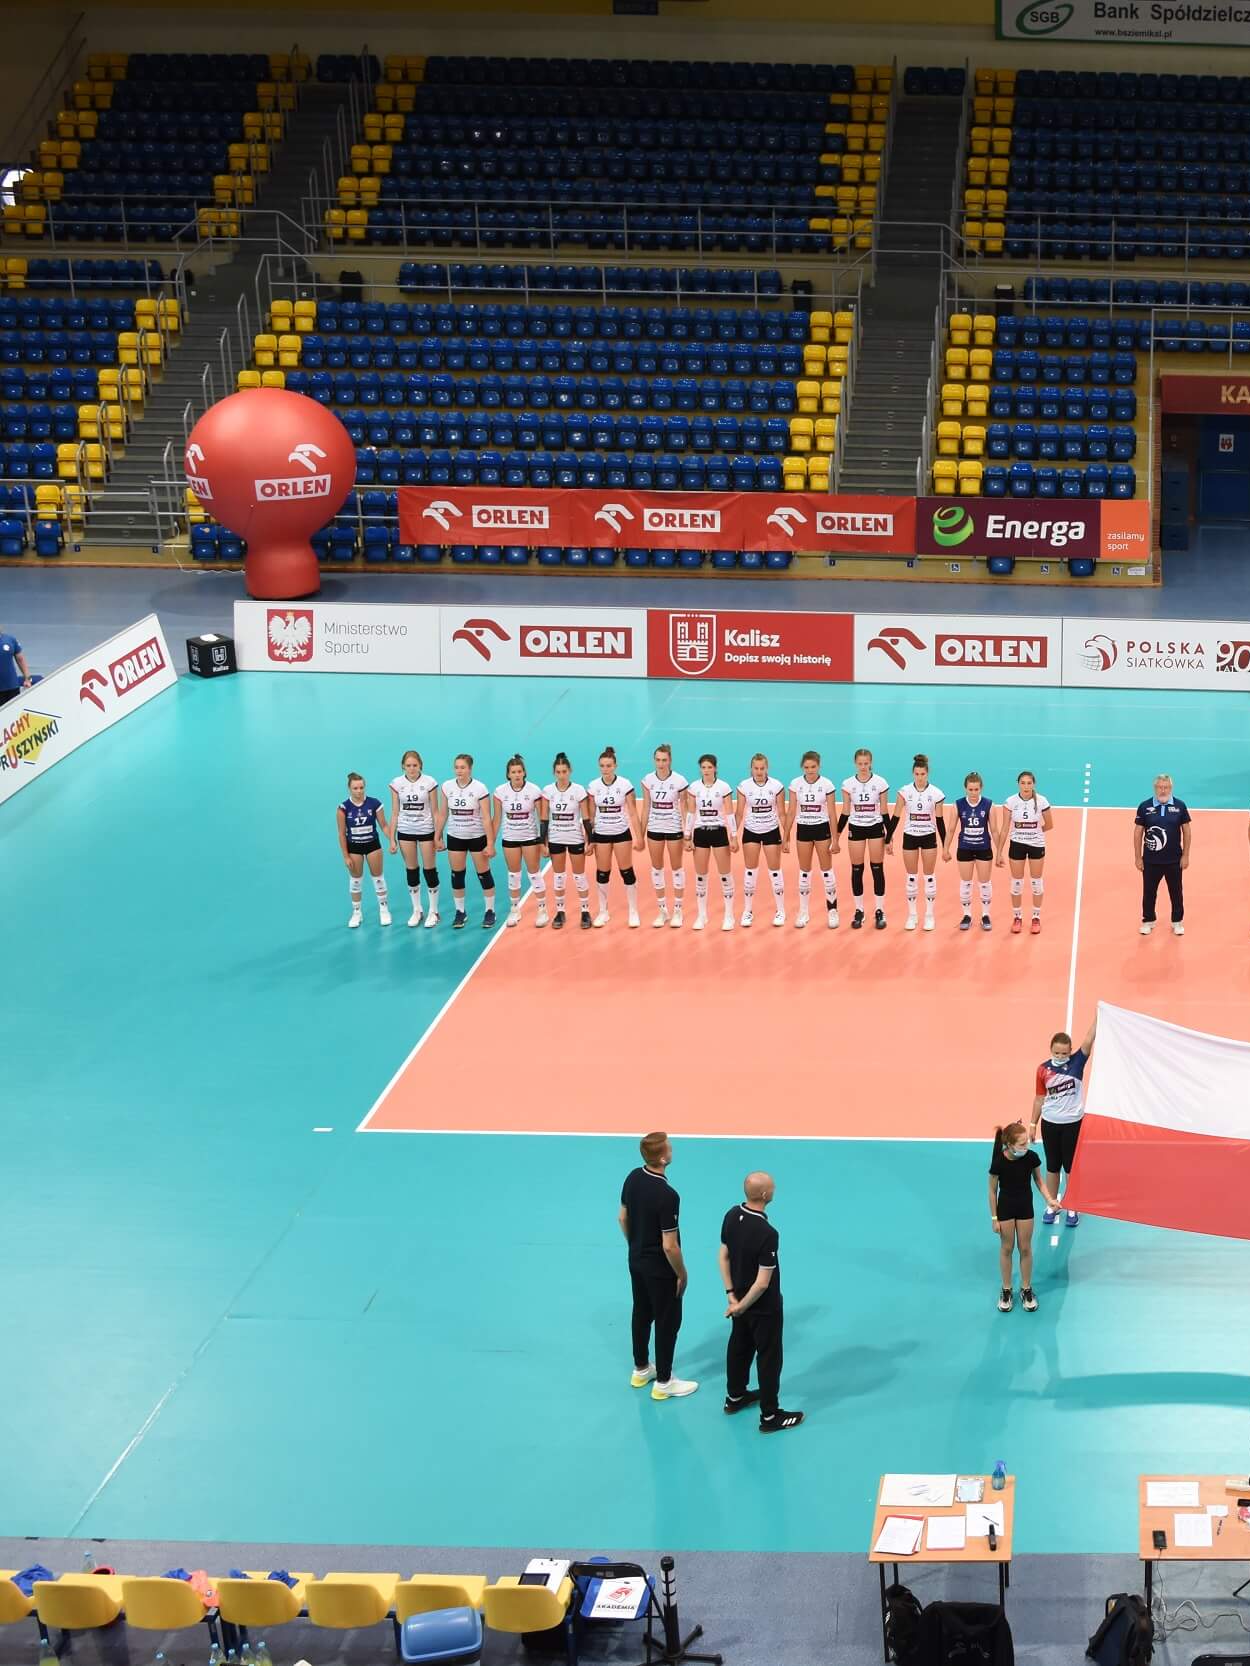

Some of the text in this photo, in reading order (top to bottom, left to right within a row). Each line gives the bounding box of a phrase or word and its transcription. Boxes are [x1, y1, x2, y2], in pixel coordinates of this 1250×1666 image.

[1093, 2, 1139, 20] Bank
[1030, 11, 1060, 24] SGB
[260, 478, 327, 497] ORLEN
[476, 508, 544, 525] ORLEN
[648, 512, 716, 529] ORLEN
[820, 515, 888, 532] ORLEN
[985, 514, 1086, 547] Energa
[1107, 531, 1145, 543] zasilamy
[1107, 542, 1129, 552] sport
[324, 621, 408, 637] Ministerstwo
[525, 629, 625, 655] ORLEN
[724, 628, 780, 647] Kalisz
[324, 639, 369, 655] Sportu
[940, 638, 1041, 664] ORLEN
[1126, 640, 1205, 656] POLSKA
[724, 652, 832, 667] Dopisz swoją historię
[1126, 655, 1205, 670] SIATKÓWKA
[113, 643, 162, 690] ORLEN
[406, 794, 419, 802] 19
[602, 796, 615, 805] 43
[655, 791, 667, 800] 77
[804, 794, 815, 802] 13
[859, 793, 870, 802] 15
[454, 798, 467, 807] 36
[510, 802, 522, 811] 18
[555, 803, 568, 812] 97
[702, 799, 713, 808] 14
[754, 798, 768, 806] 70
[916, 802, 923, 811] 9
[354, 816, 368, 826] 17
[967, 817, 980, 826] 16
[1022, 811, 1029, 820] 5
